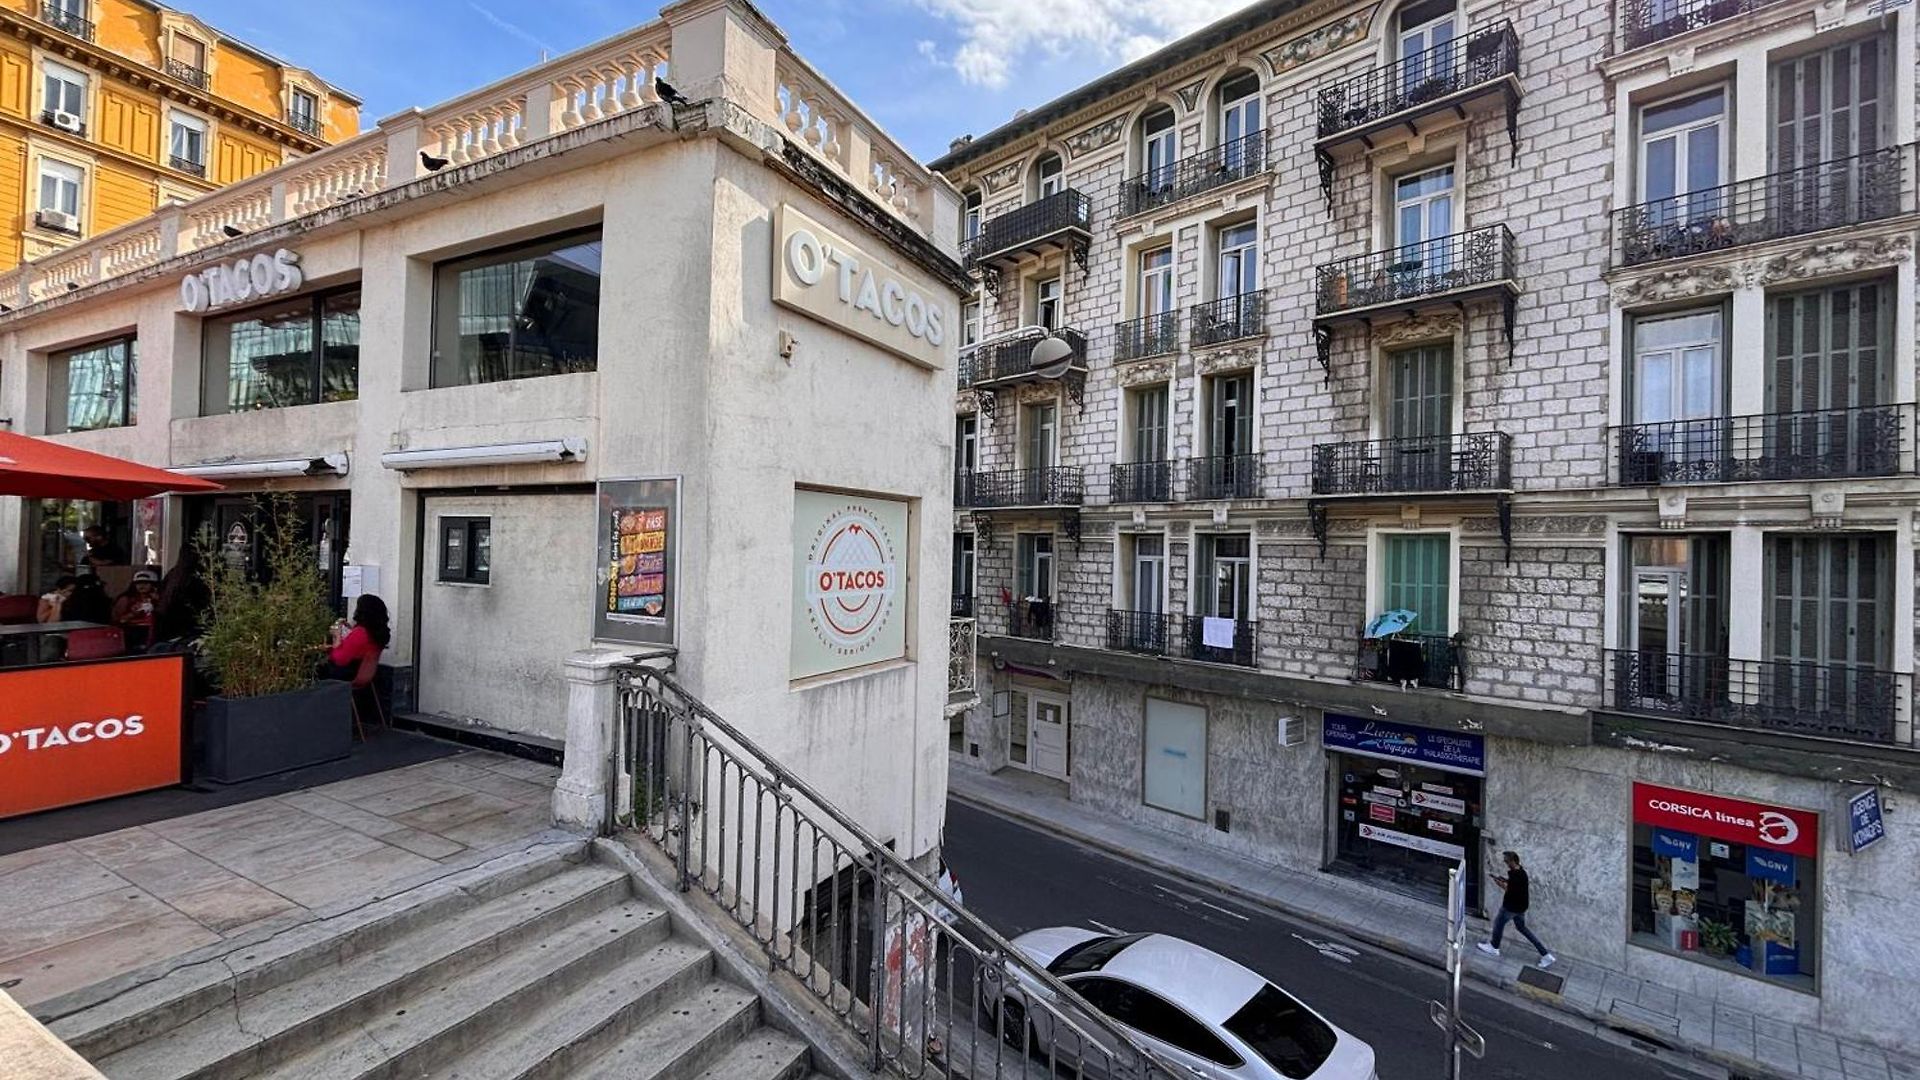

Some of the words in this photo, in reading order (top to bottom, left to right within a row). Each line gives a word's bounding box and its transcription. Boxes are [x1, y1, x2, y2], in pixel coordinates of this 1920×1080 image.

[181, 248, 302, 312] O'TACOS
[790, 229, 944, 346] O'TACOS
[820, 570, 884, 591] O'TACOS
[1376, 739, 1418, 755] Voyages
[1648, 799, 1713, 820] CORSICA
[1853, 793, 1876, 817] AGENCE
[1672, 838, 1691, 850] GNV
[1767, 862, 1788, 873] GNV
